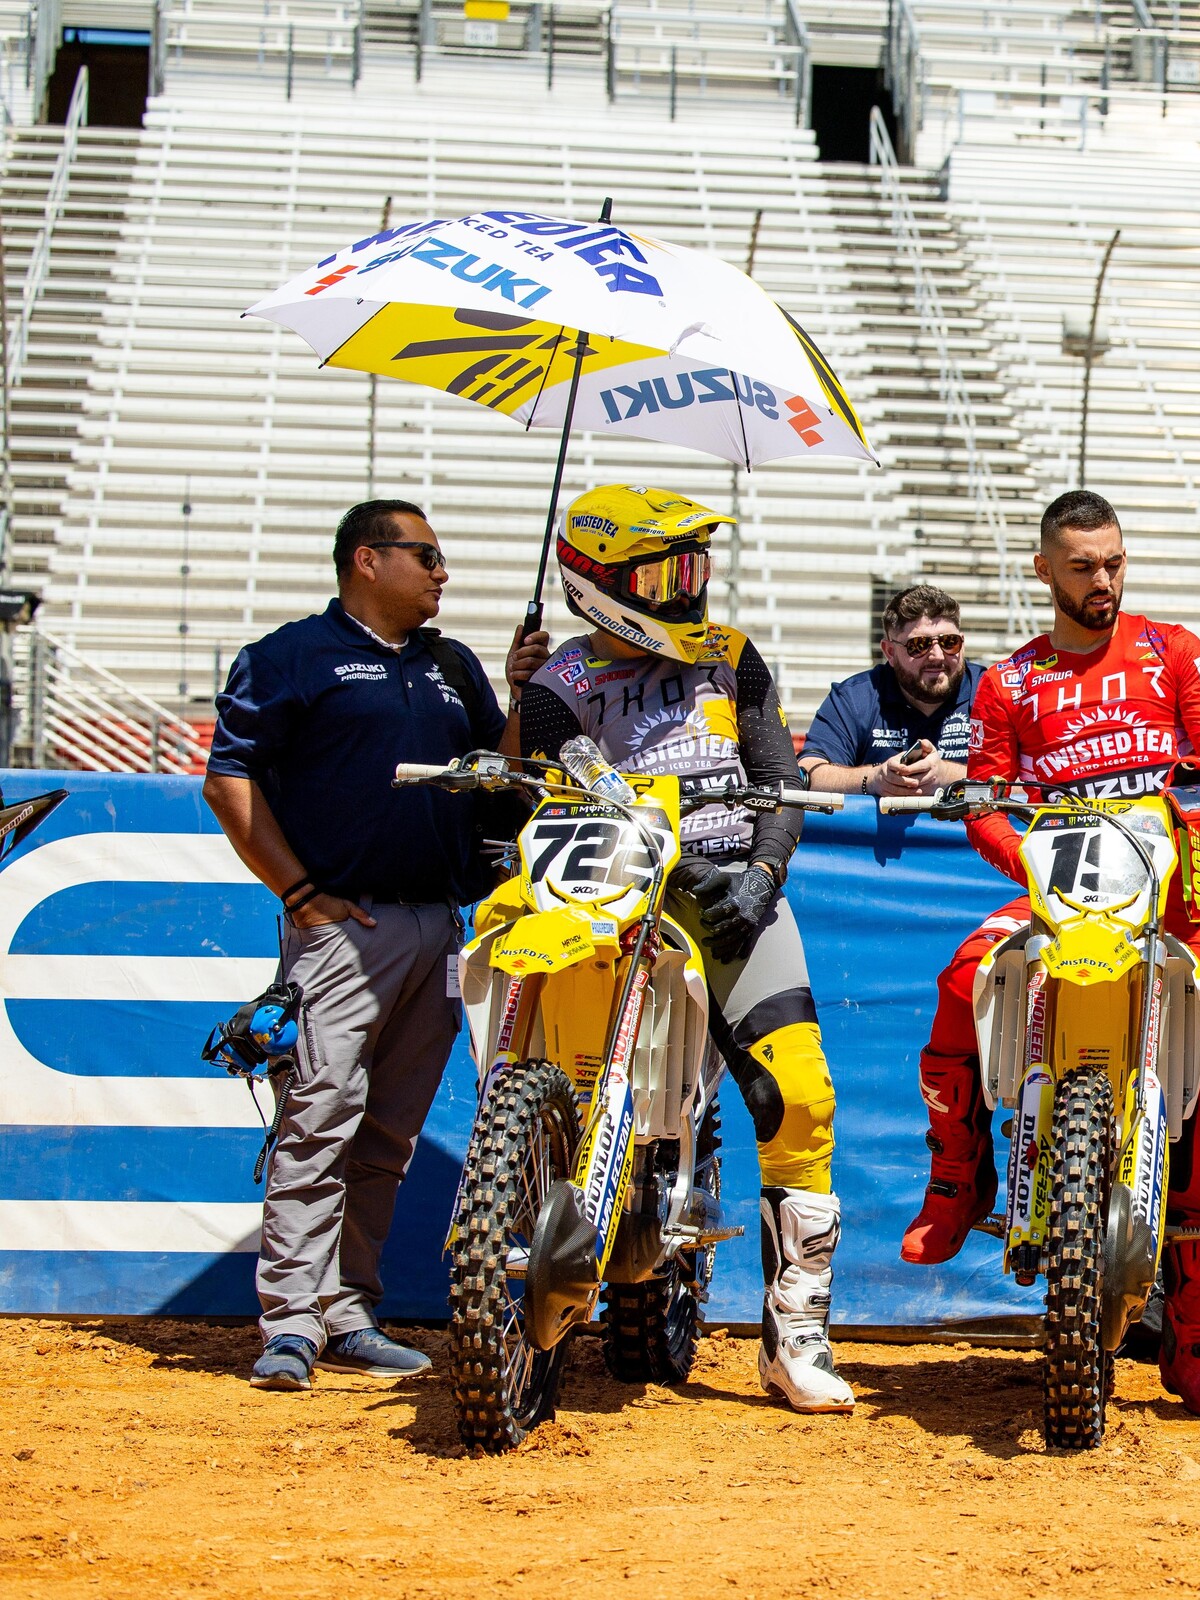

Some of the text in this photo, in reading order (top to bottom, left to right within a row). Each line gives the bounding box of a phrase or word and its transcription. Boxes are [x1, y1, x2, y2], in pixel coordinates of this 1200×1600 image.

[458, 216, 508, 239] ICED
[514, 240, 555, 262] TEA
[357, 237, 553, 309] SUZUKI
[572, 515, 619, 538] TWISTED TEA
[587, 606, 665, 652] PROGRESSIVE
[334, 663, 386, 675] SUZUKI
[341, 672, 388, 681] PROGRESSIVE
[1031, 670, 1073, 687] SHOWA
[617, 734, 740, 773] WISTED TEA
[670, 761, 691, 771] ICED
[695, 759, 712, 768] TEA
[1036, 728, 1173, 778] TWISTED TEA
[1072, 755, 1150, 776] HARD ICED TEA
[743, 797, 777, 808] ARC
[1048, 769, 1169, 802] SUZUK
[530, 822, 665, 893] 722
[1055, 958, 1114, 974] TWISTED TEA
[499, 981, 523, 1053] NOLEE
[1030, 990, 1047, 1065] NOLEEN
[586, 1112, 616, 1225] DUNLOP
[610, 1109, 634, 1191] ECSTAR
[1016, 1113, 1036, 1219] DUNLOP
[1139, 1116, 1155, 1220] DUNLOP
[1155, 1114, 1168, 1187] ECSTAR
[614, 1158, 633, 1217] GALFER
